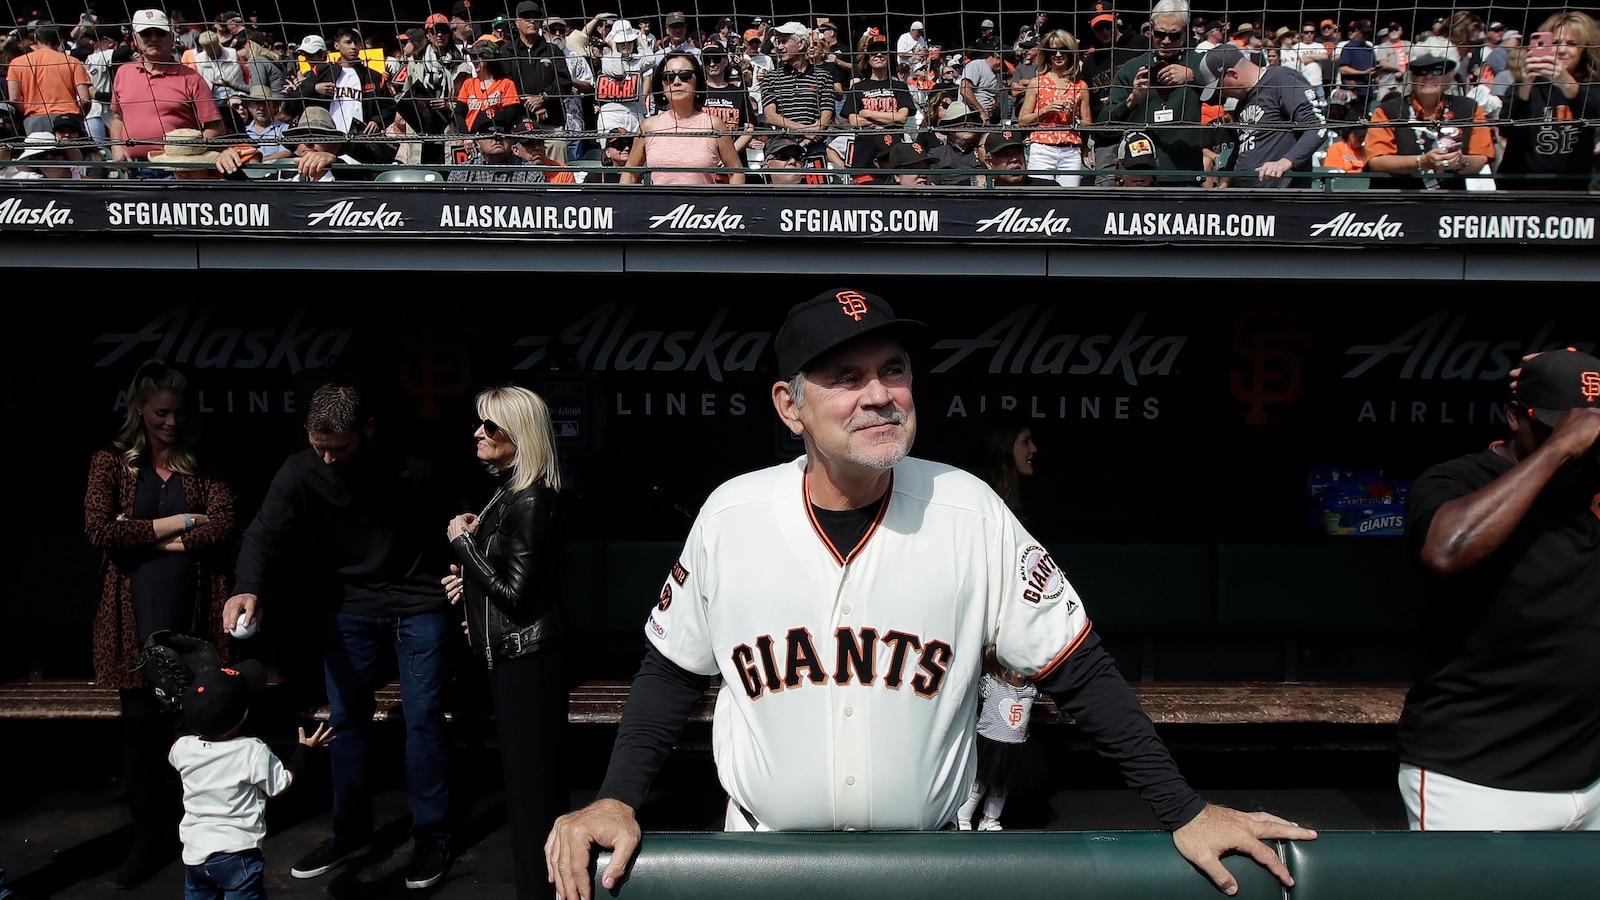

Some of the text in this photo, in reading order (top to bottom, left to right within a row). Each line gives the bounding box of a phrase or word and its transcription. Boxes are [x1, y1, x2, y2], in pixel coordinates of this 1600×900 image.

[1535, 129, 1582, 155] SF
[109, 202, 270, 227] SFGIANTS.COM
[308, 200, 402, 230] Alaska
[440, 205, 614, 229] ALASKAAIR.COM
[649, 203, 744, 232] Alaska
[780, 208, 939, 232] SFGIANTS.COM
[976, 206, 1071, 236] Alaska
[1104, 212, 1276, 236] ALASKAAIR.COM
[1310, 211, 1403, 240] Alaska
[1439, 215, 1595, 239] SFGIANTS.COM
[92, 298, 352, 375] Alaska
[512, 299, 773, 382] Alaska
[930, 302, 1189, 386] Alaska
[616, 392, 746, 416] LINES
[1357, 400, 1506, 424] AIRLIN
[1360, 515, 1403, 533] GIANTS
[731, 626, 954, 701] GIANTS
